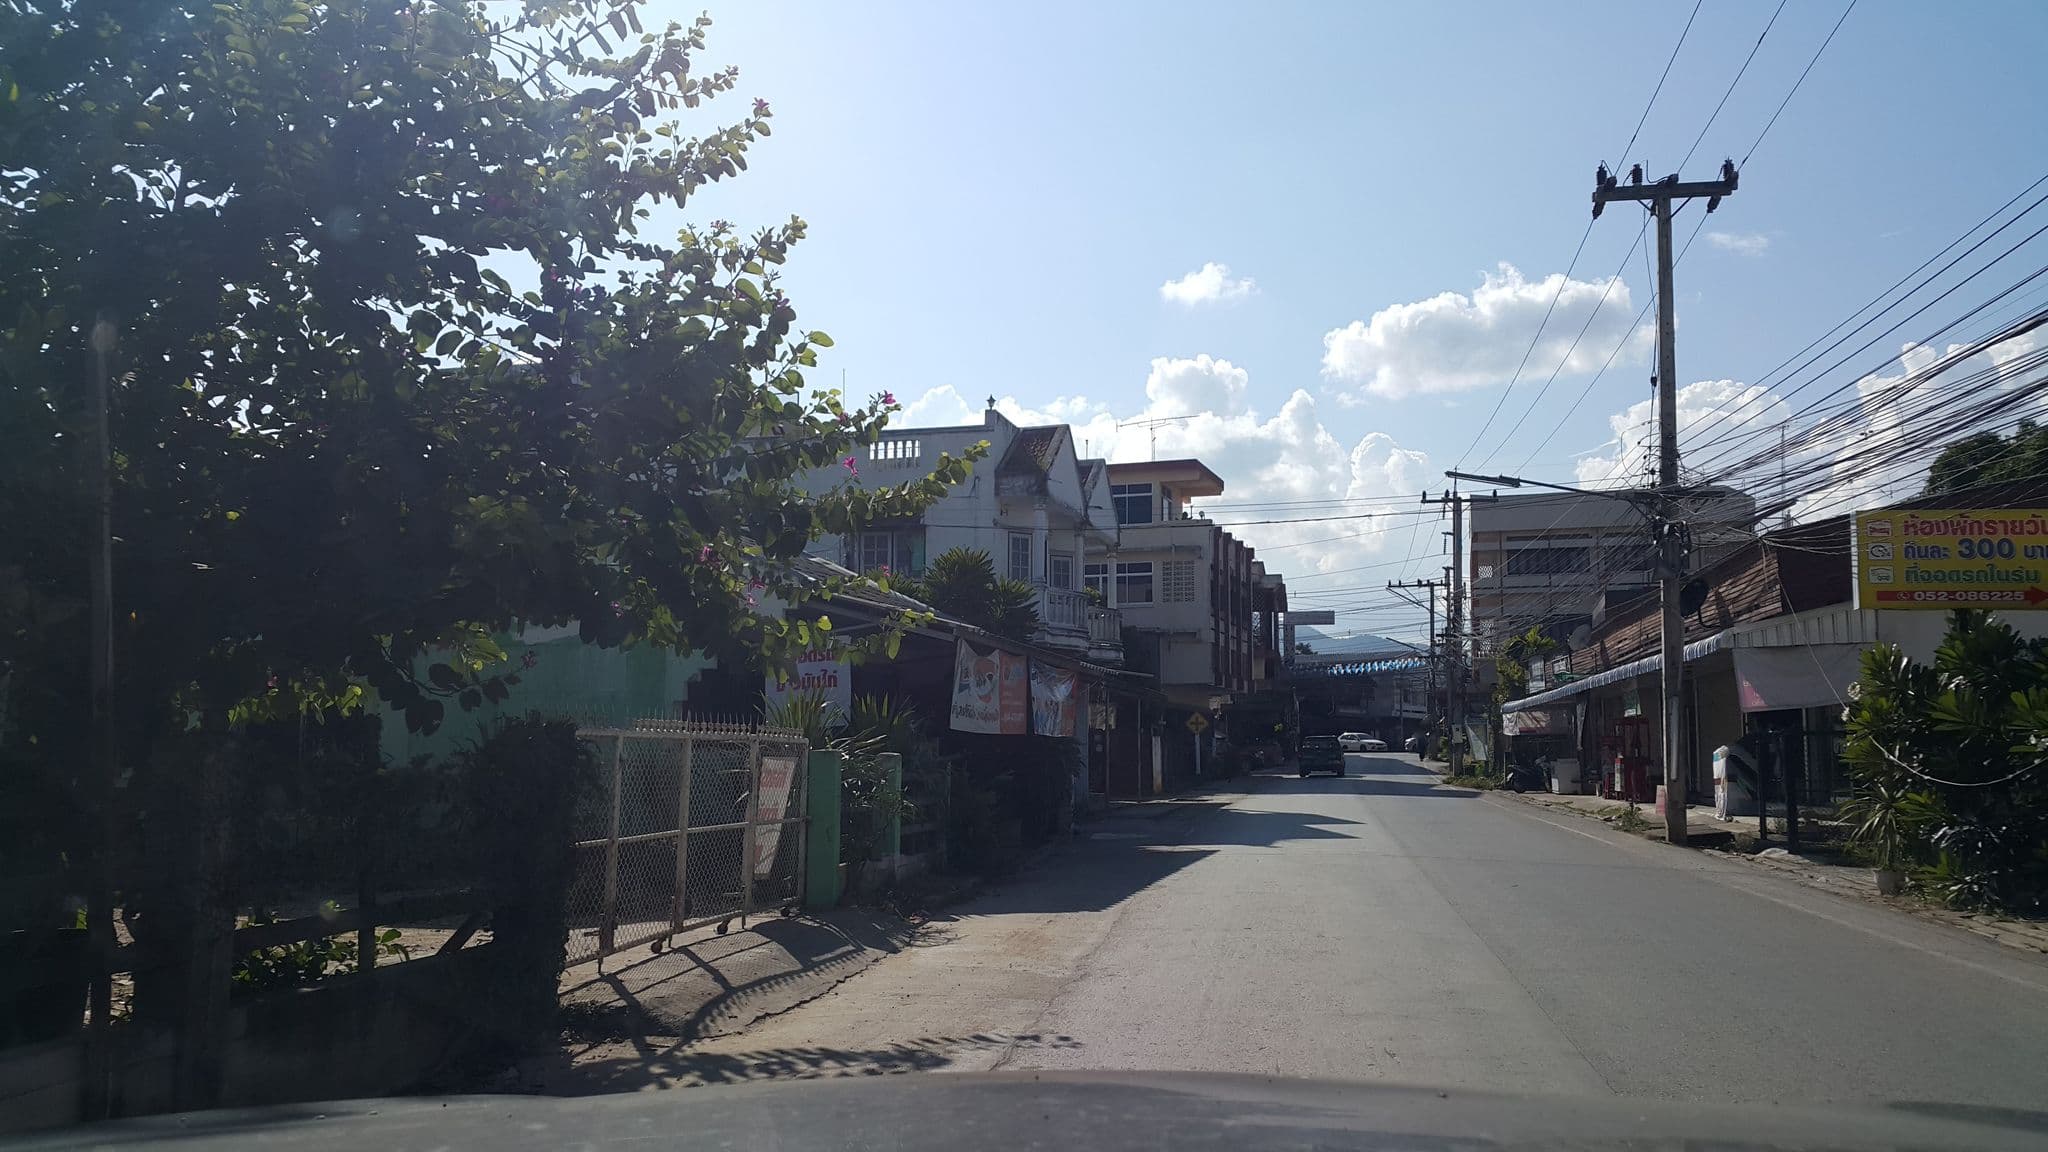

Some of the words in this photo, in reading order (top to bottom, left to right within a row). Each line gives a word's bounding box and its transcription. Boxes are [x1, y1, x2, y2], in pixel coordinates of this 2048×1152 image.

[1904, 540, 1951, 559] คืนละ
[1958, 538, 2016, 559] 300
[1905, 562, 2040, 583] ที่จอดรถในร่ม
[1914, 591, 2025, 601] 052-086225
